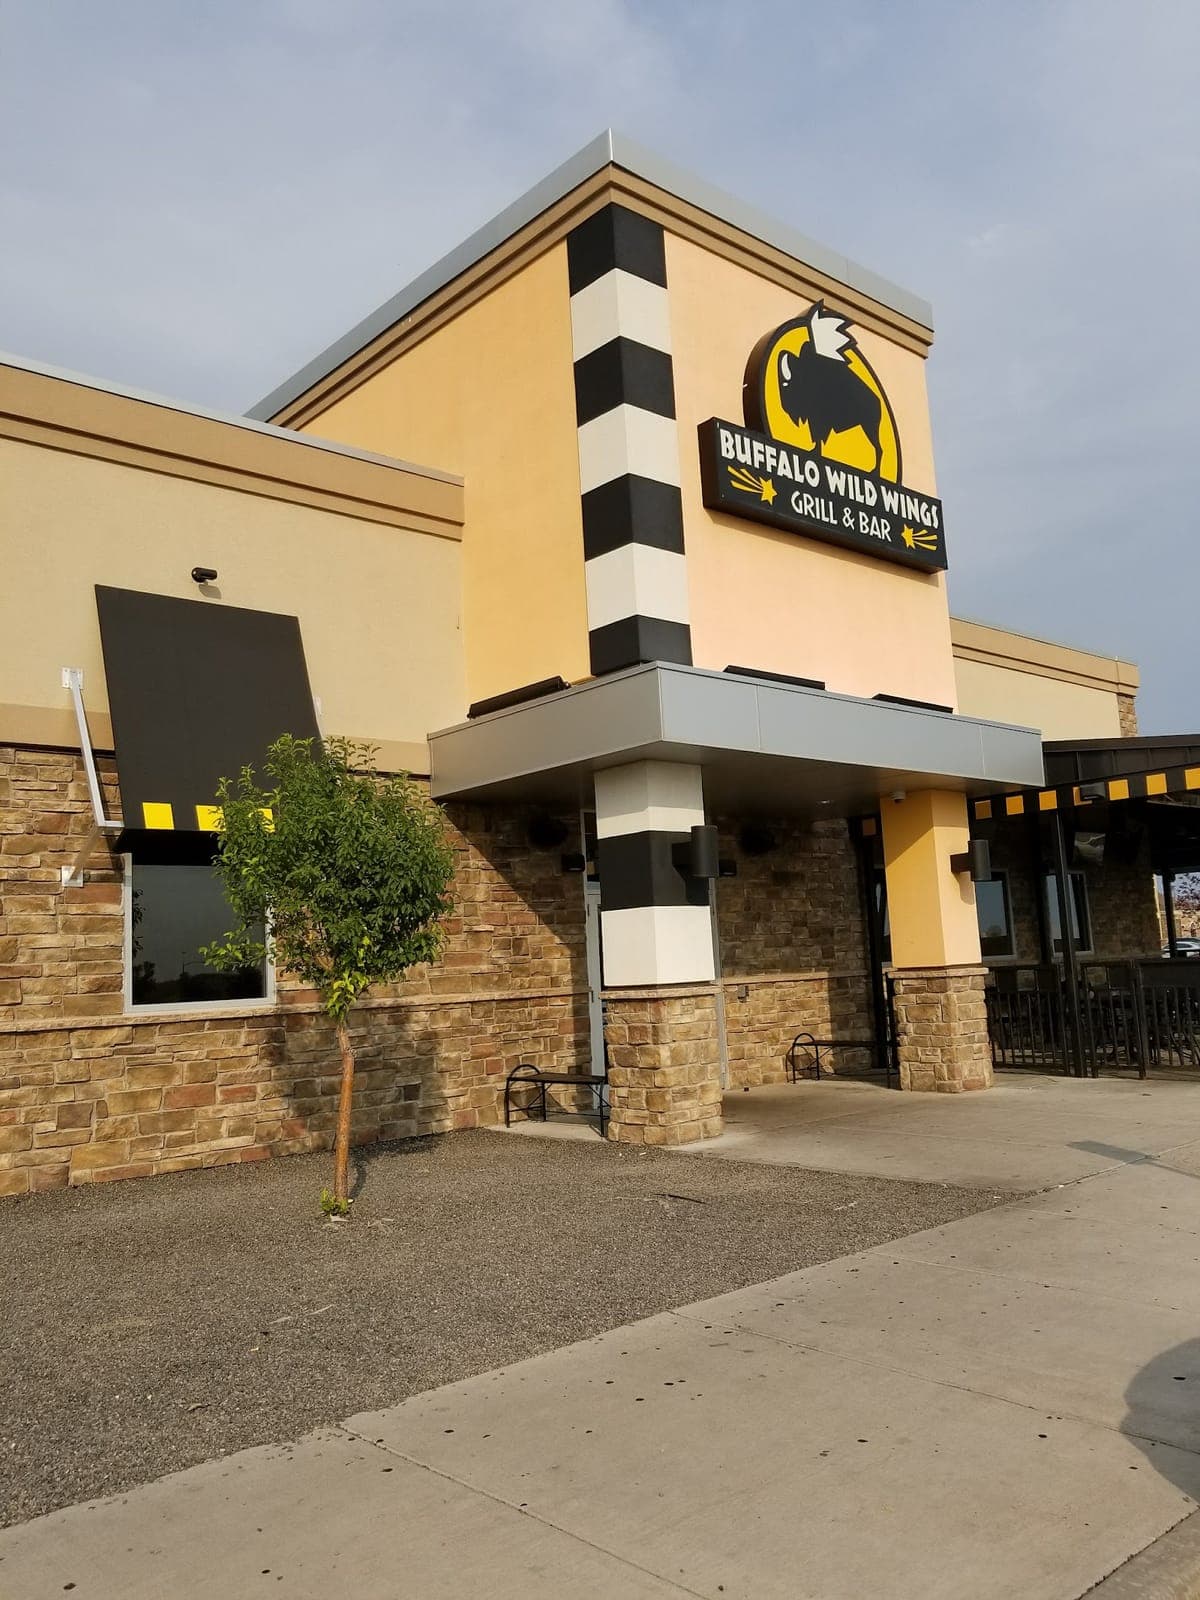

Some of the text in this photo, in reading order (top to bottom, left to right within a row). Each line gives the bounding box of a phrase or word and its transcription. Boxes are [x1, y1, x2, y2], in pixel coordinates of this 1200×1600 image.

[720, 429, 939, 529] BUFFALO WILD WINGS
[791, 491, 892, 542] GRILL & BAR
